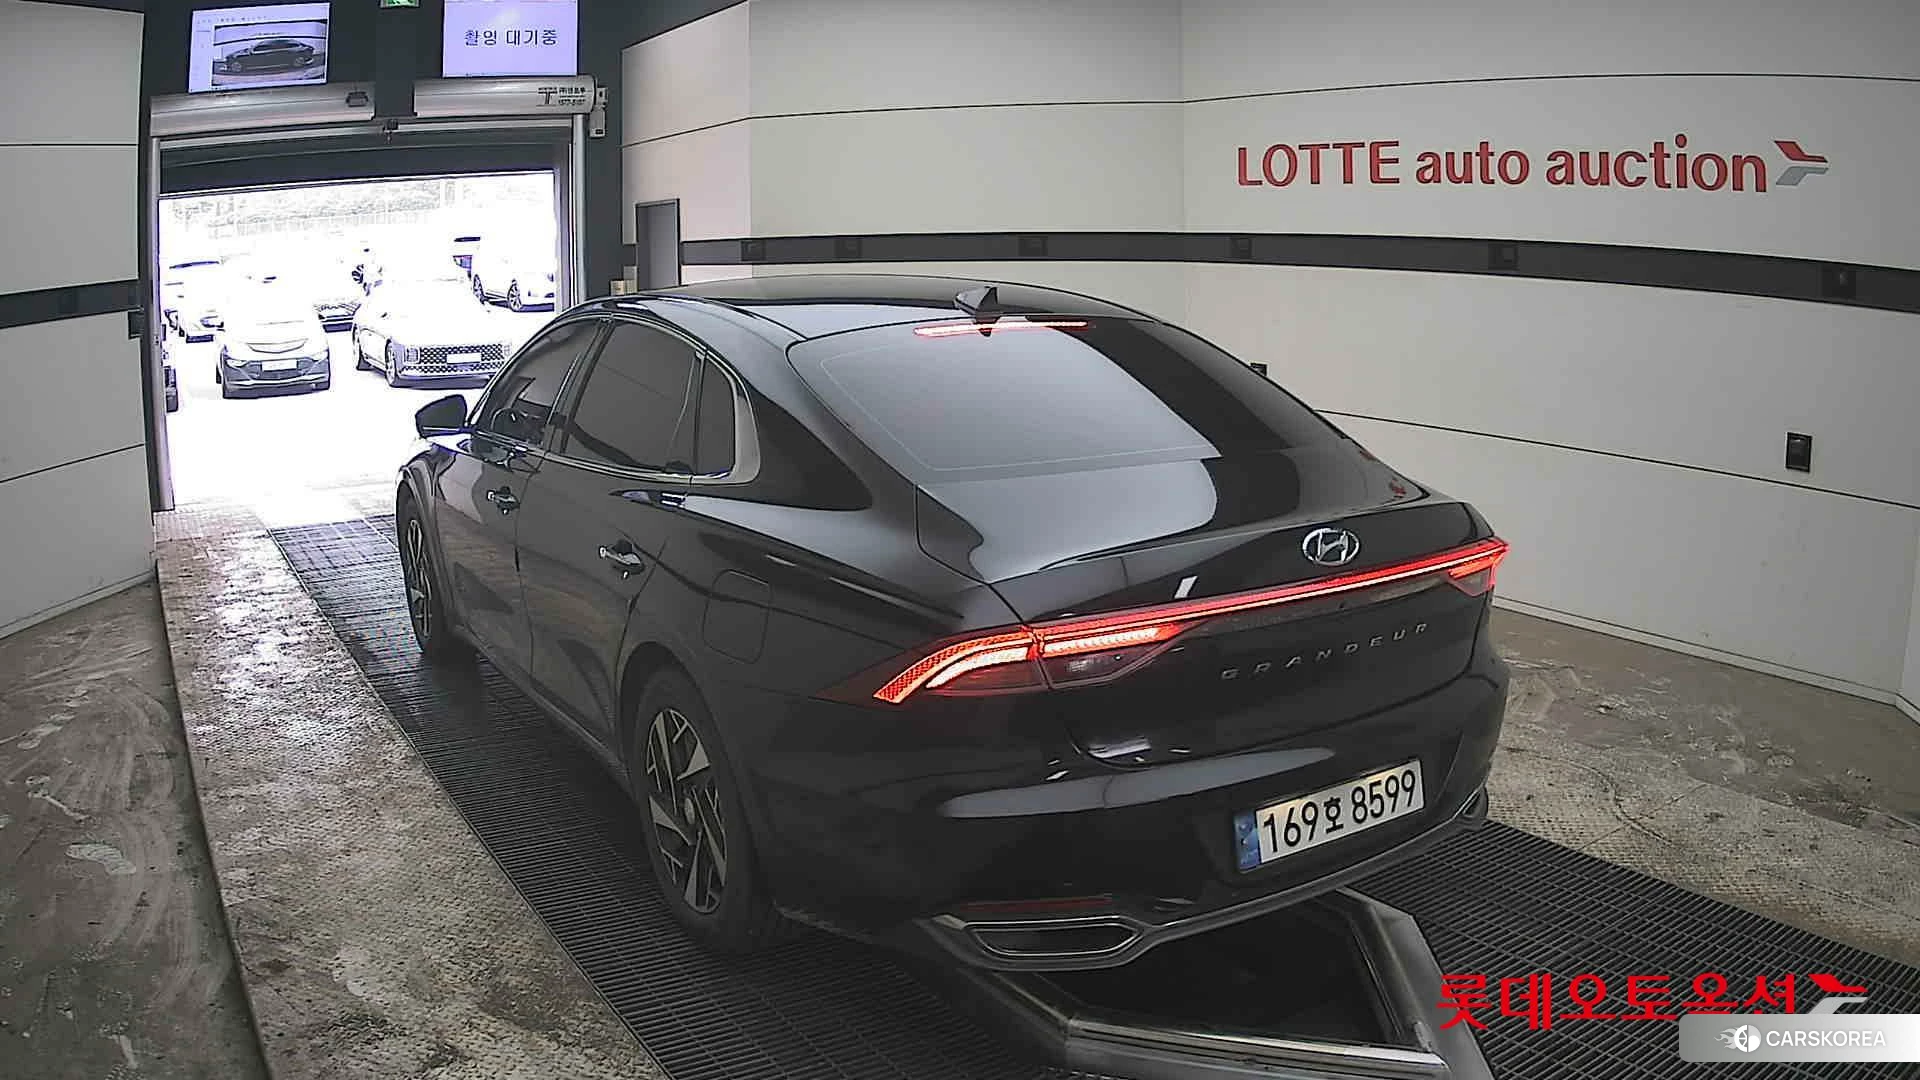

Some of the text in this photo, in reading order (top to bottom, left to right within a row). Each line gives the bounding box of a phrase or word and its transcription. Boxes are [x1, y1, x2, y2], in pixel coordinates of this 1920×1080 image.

[506, 30, 557, 46] 대기중
[1238, 134, 1768, 192] LOTTE auto auction
[1221, 623, 1427, 679] GRANDEUR
[1263, 769, 1416, 853] 169호 8599
